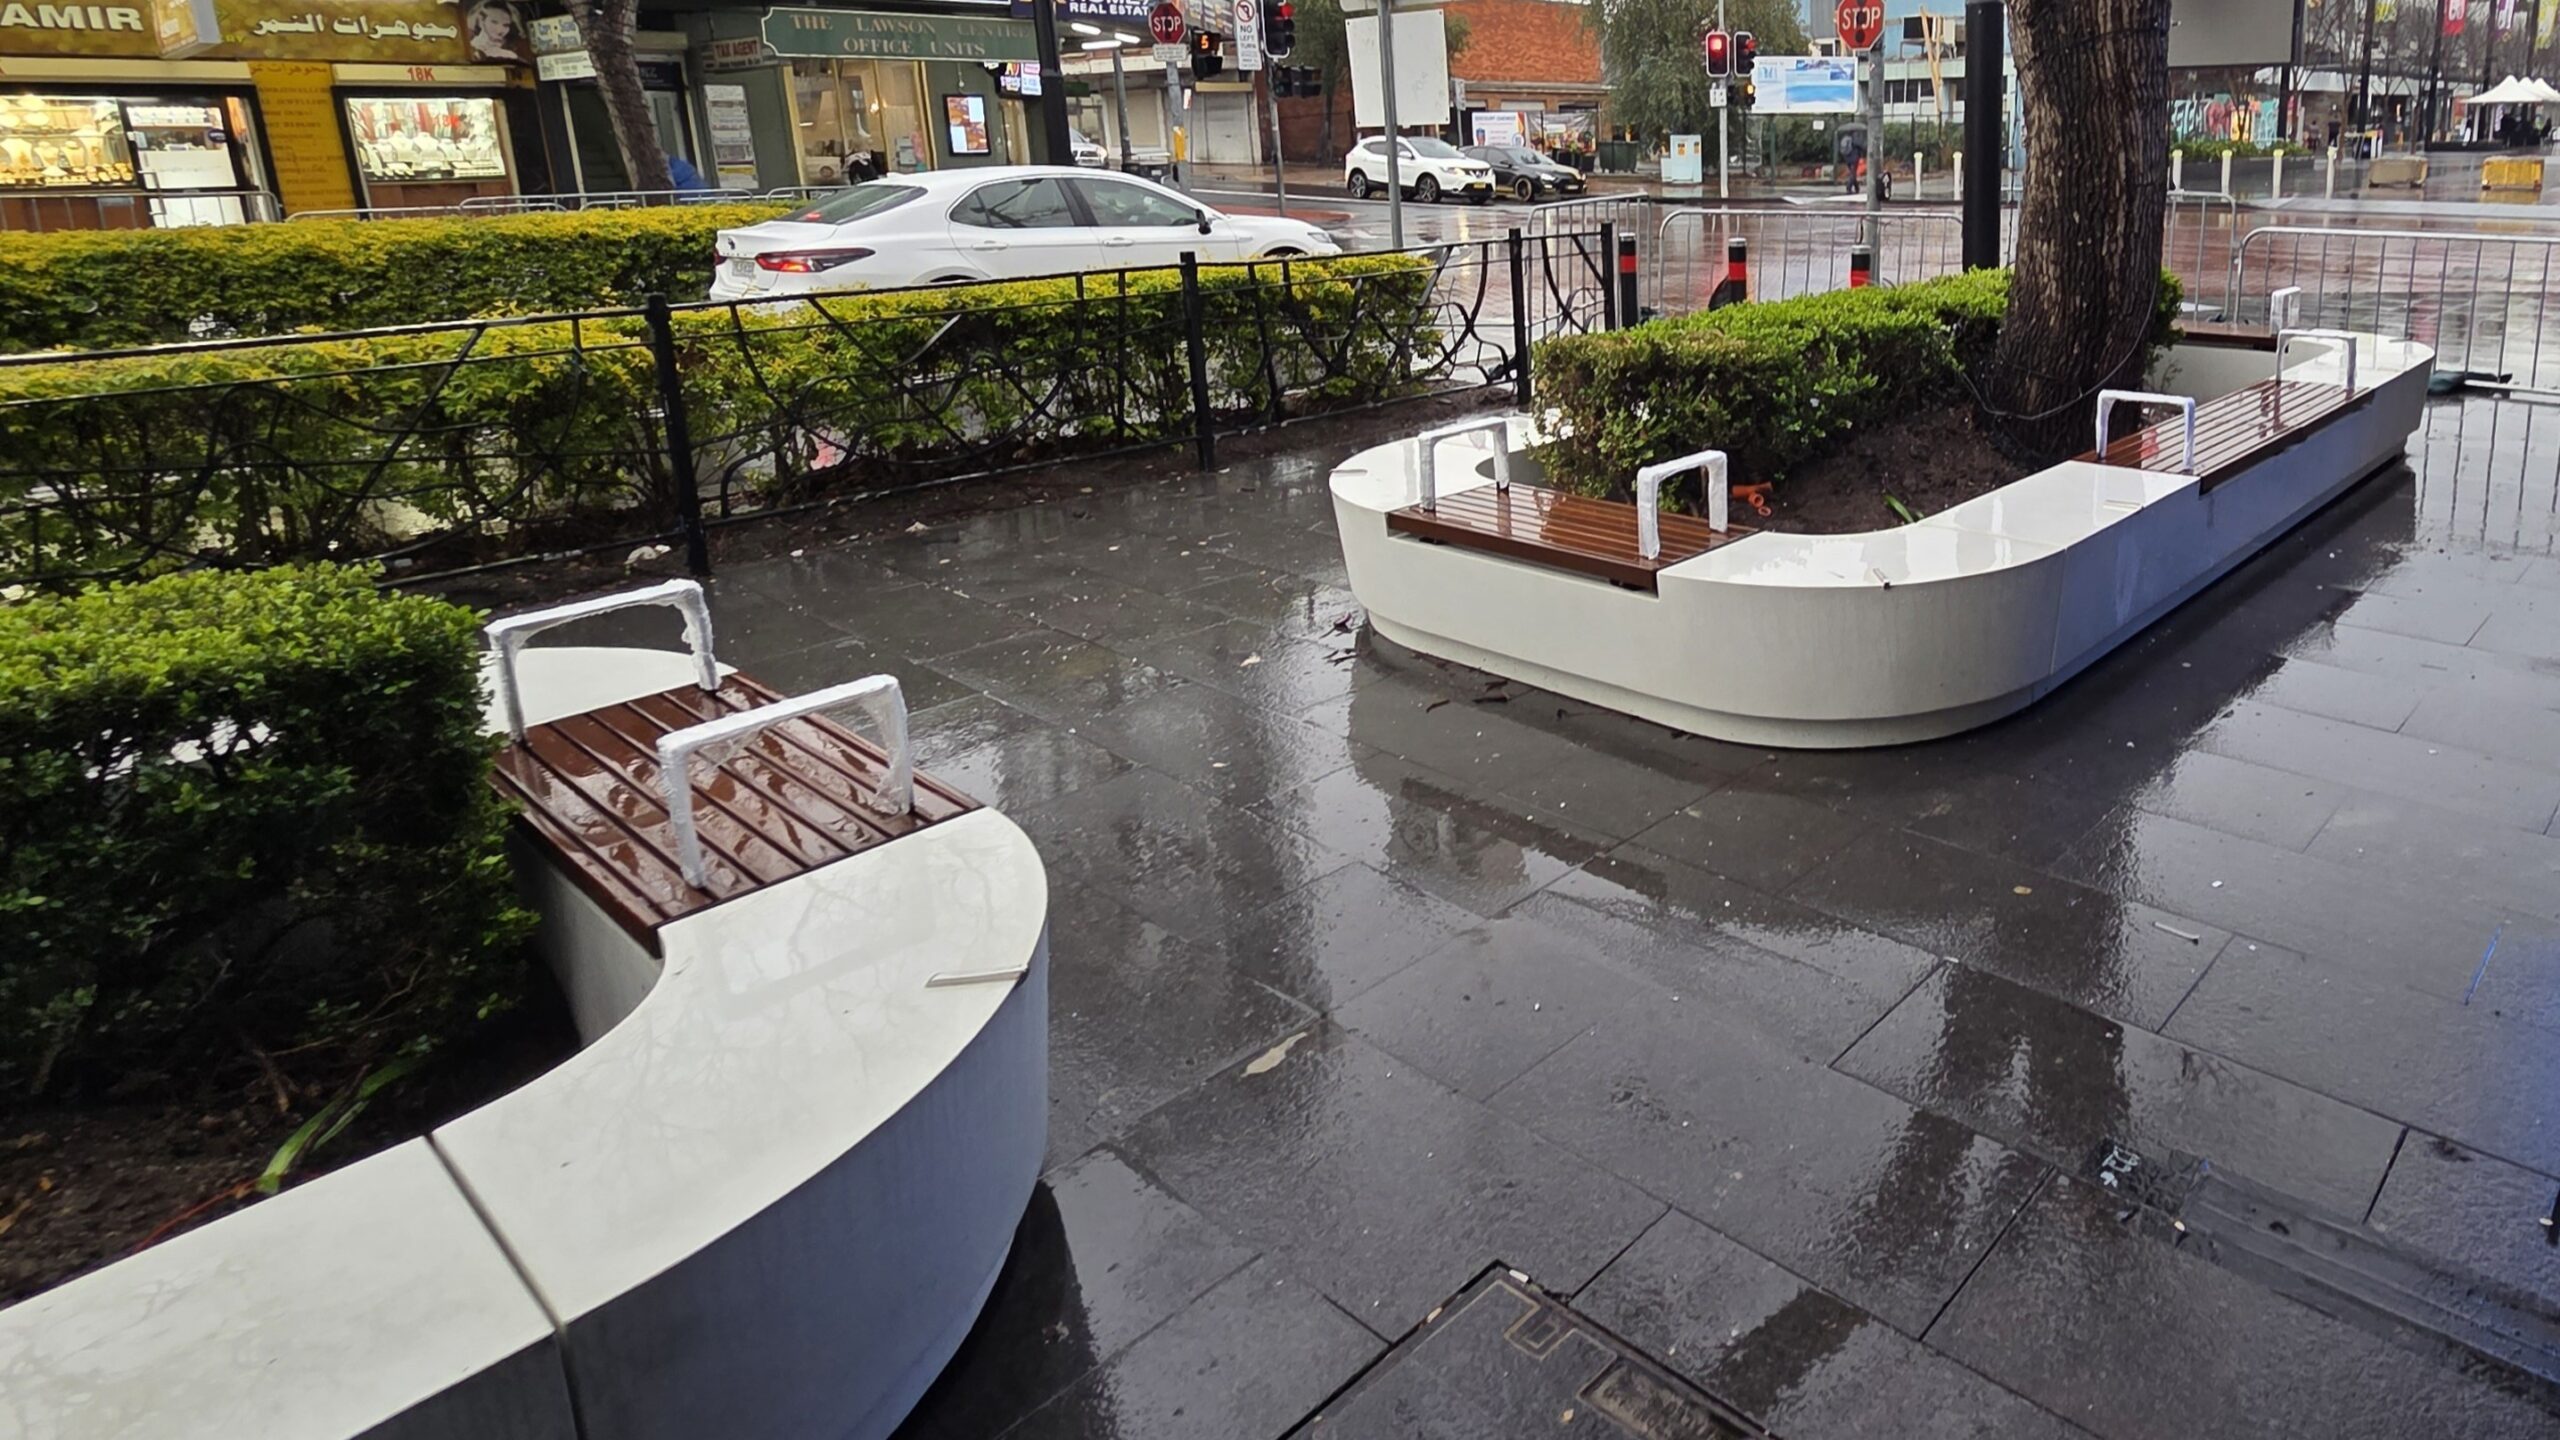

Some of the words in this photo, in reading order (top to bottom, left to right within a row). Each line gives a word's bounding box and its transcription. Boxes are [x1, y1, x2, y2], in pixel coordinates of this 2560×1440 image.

[0, 3, 144, 31] AMIR
[1069, 2, 1107, 14] REAL
[1109, 5, 1149, 16] ESTAT
[253, 13, 324, 36] النمر
[790, 14, 833, 30] THE
[856, 17, 936, 34] LAWSON
[957, 24, 1030, 38] CENTRE
[1154, 16, 1181, 32] STOP
[1842, 7, 1881, 30] STOP
[332, 16, 458, 41] مجوهرات
[1240, 24, 1253, 34] NO
[715, 42, 731, 57] TAX
[733, 40, 757, 56] AGENT
[843, 37, 914, 54] OFFICE
[931, 40, 985, 56] UNITS
[1201, 35, 1209, 49] 5
[407, 66, 436, 81] 18K
